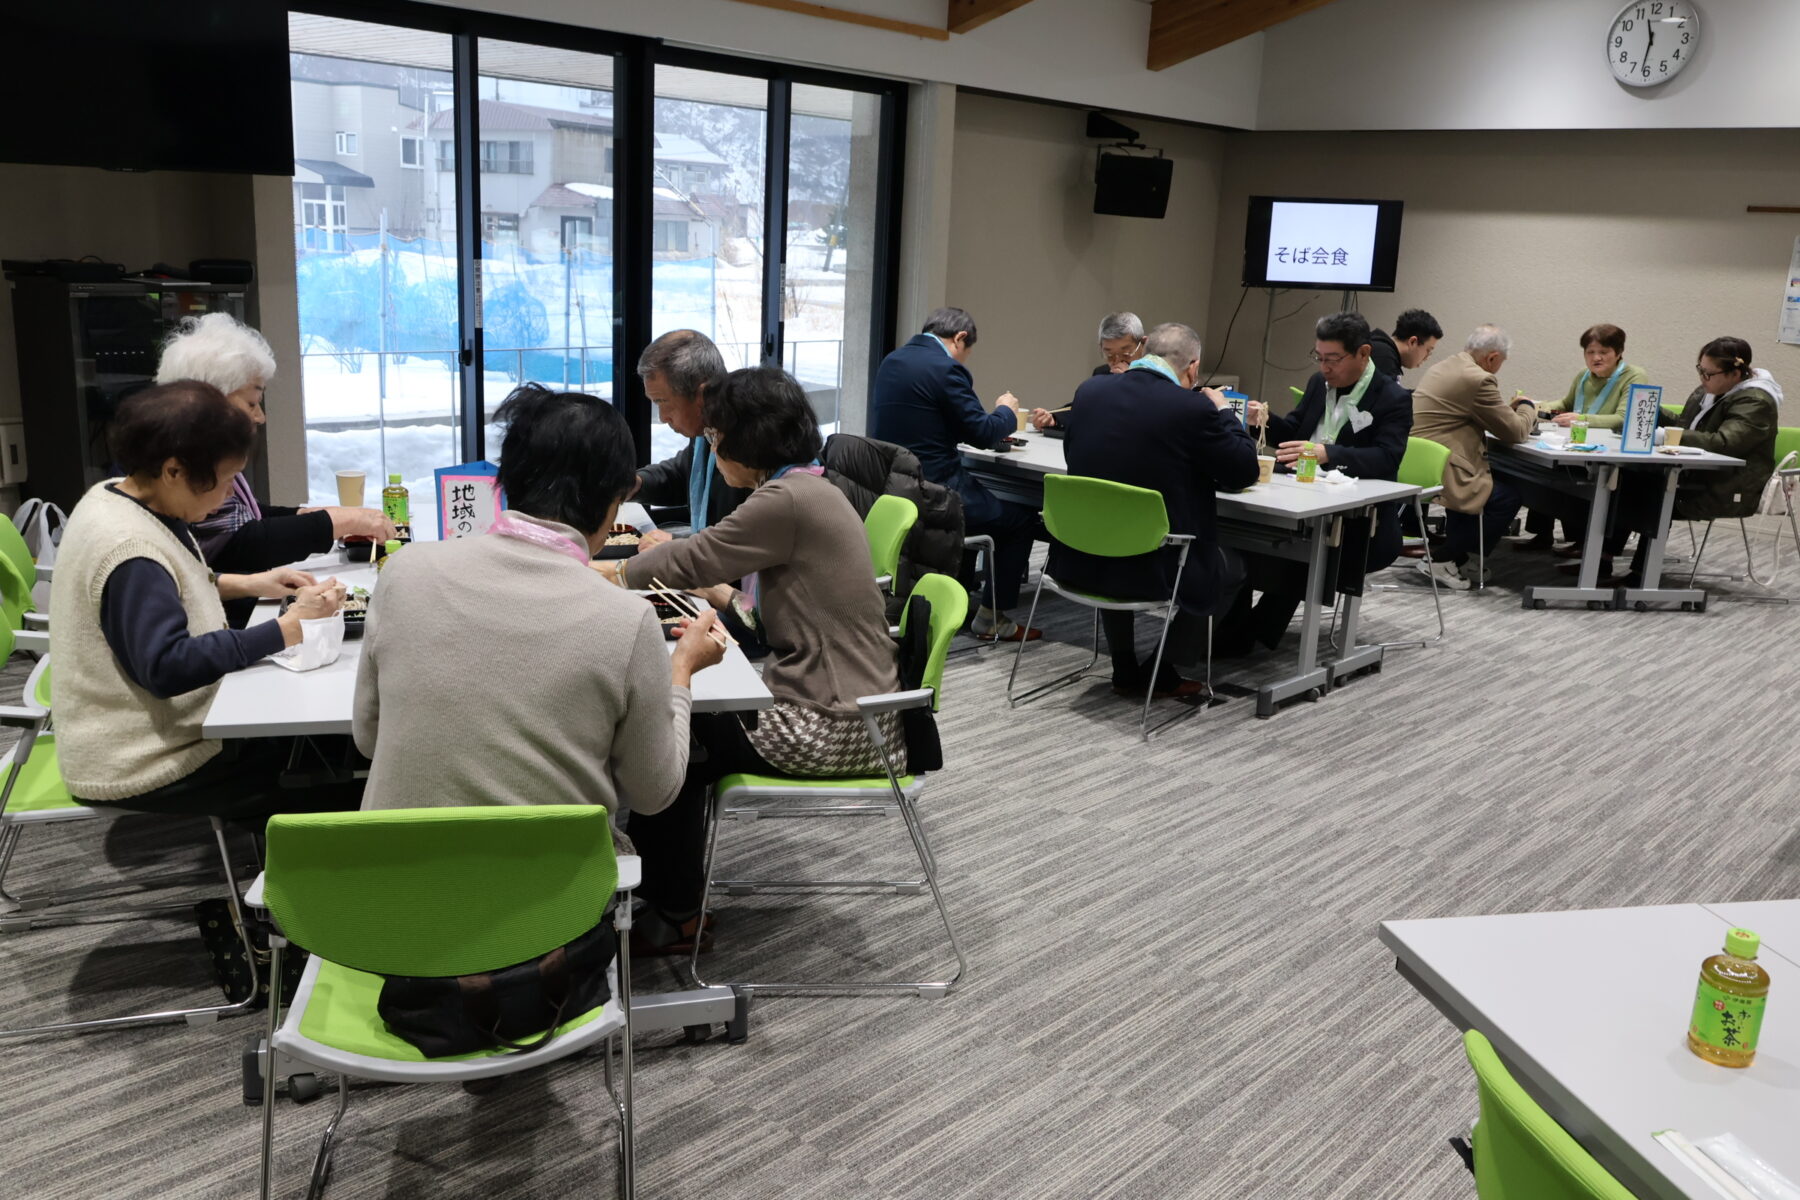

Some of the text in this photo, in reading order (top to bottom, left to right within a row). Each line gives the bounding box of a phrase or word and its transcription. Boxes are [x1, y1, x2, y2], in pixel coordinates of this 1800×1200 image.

[1636, 8, 1645, 20] 11
[1651, 2, 1663, 15] 12
[1669, 6, 1674, 18] 1
[1622, 20, 1633, 32] 10
[1677, 16, 1686, 28] 2
[1614, 36, 1623, 48] 9
[1681, 32, 1690, 45] 3
[1619, 51, 1628, 63] 8
[1672, 48, 1680, 60] 4
[1630, 61, 1637, 74] 7
[1642, 65, 1651, 78] 6
[1659, 60, 1668, 73] 5
[1274, 247, 1349, 266] そば会食
[1635, 399, 1648, 440] のみなさま
[452, 484, 475, 539] 地域の
[1721, 1010, 1742, 1047] お茶
